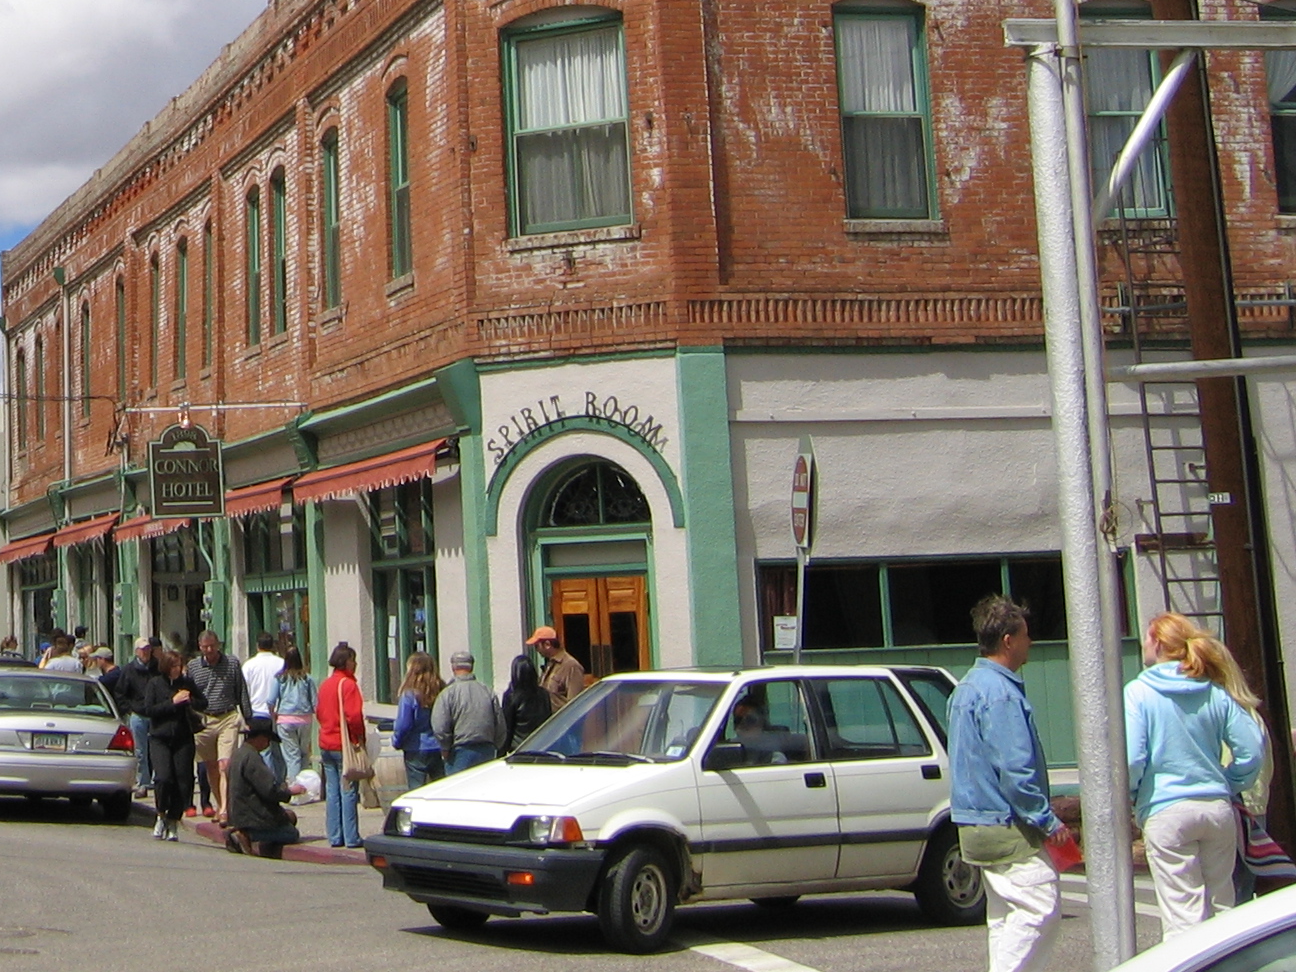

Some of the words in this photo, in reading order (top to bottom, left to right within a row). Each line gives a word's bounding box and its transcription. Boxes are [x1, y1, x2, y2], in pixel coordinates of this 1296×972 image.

[487, 395, 560, 459] SPIRIT
[585, 391, 664, 445] ROOM
[154, 458, 219, 475] CONNOR
[162, 482, 214, 498] HOTEL
